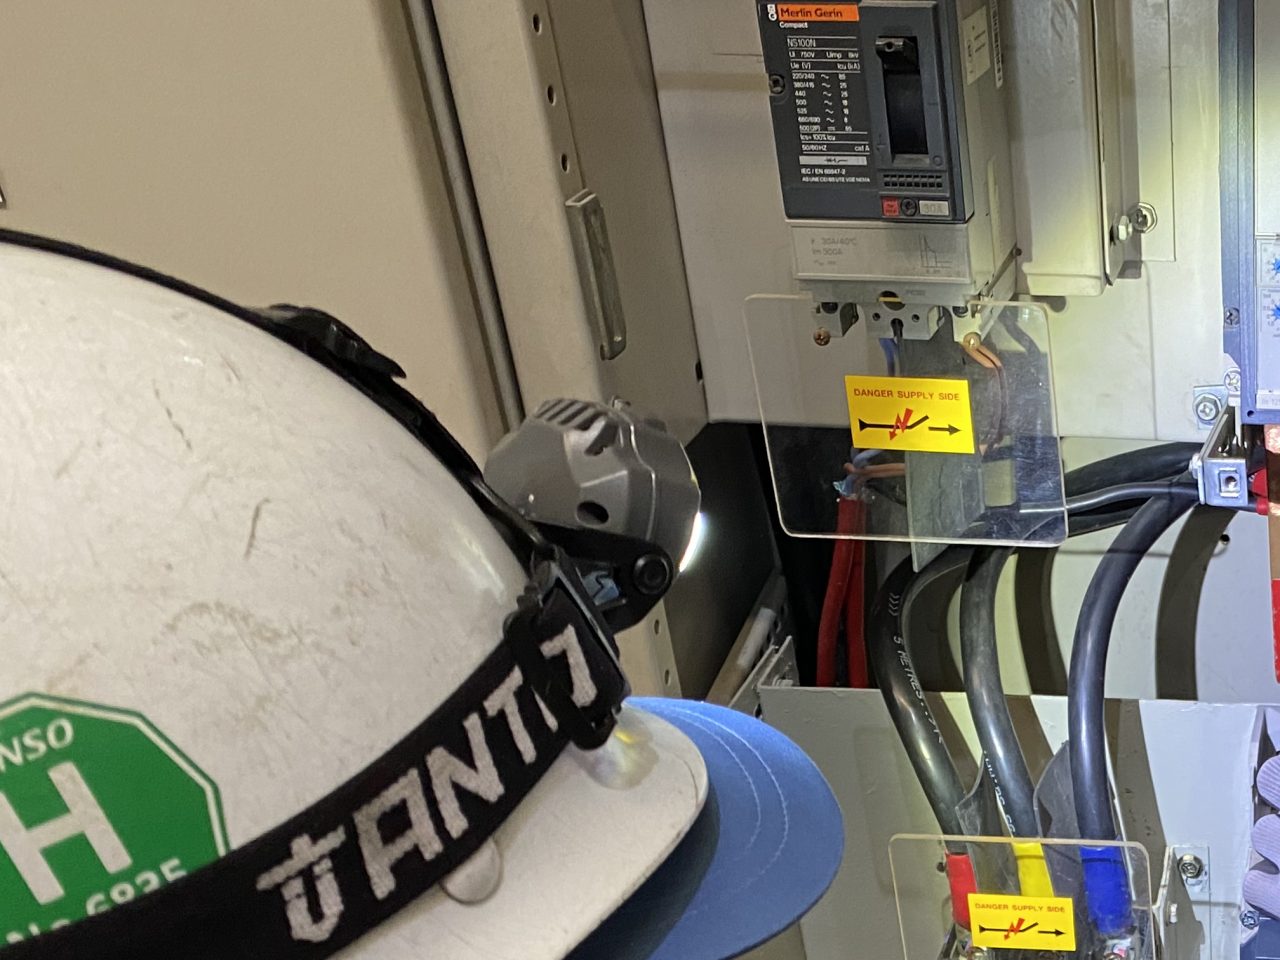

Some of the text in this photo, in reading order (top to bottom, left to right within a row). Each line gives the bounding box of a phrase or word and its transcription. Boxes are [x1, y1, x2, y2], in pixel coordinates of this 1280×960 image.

[780, 8, 812, 18] Merlin
[815, 8, 843, 18] Gerin
[779, 22, 808, 30] Compact
[787, 39, 816, 48] NS100N
[853, 388, 960, 401] DANGER SUPPLY SIDE
[0, 761, 133, 906] H
[1012, 904, 1043, 912] SUPPLY
